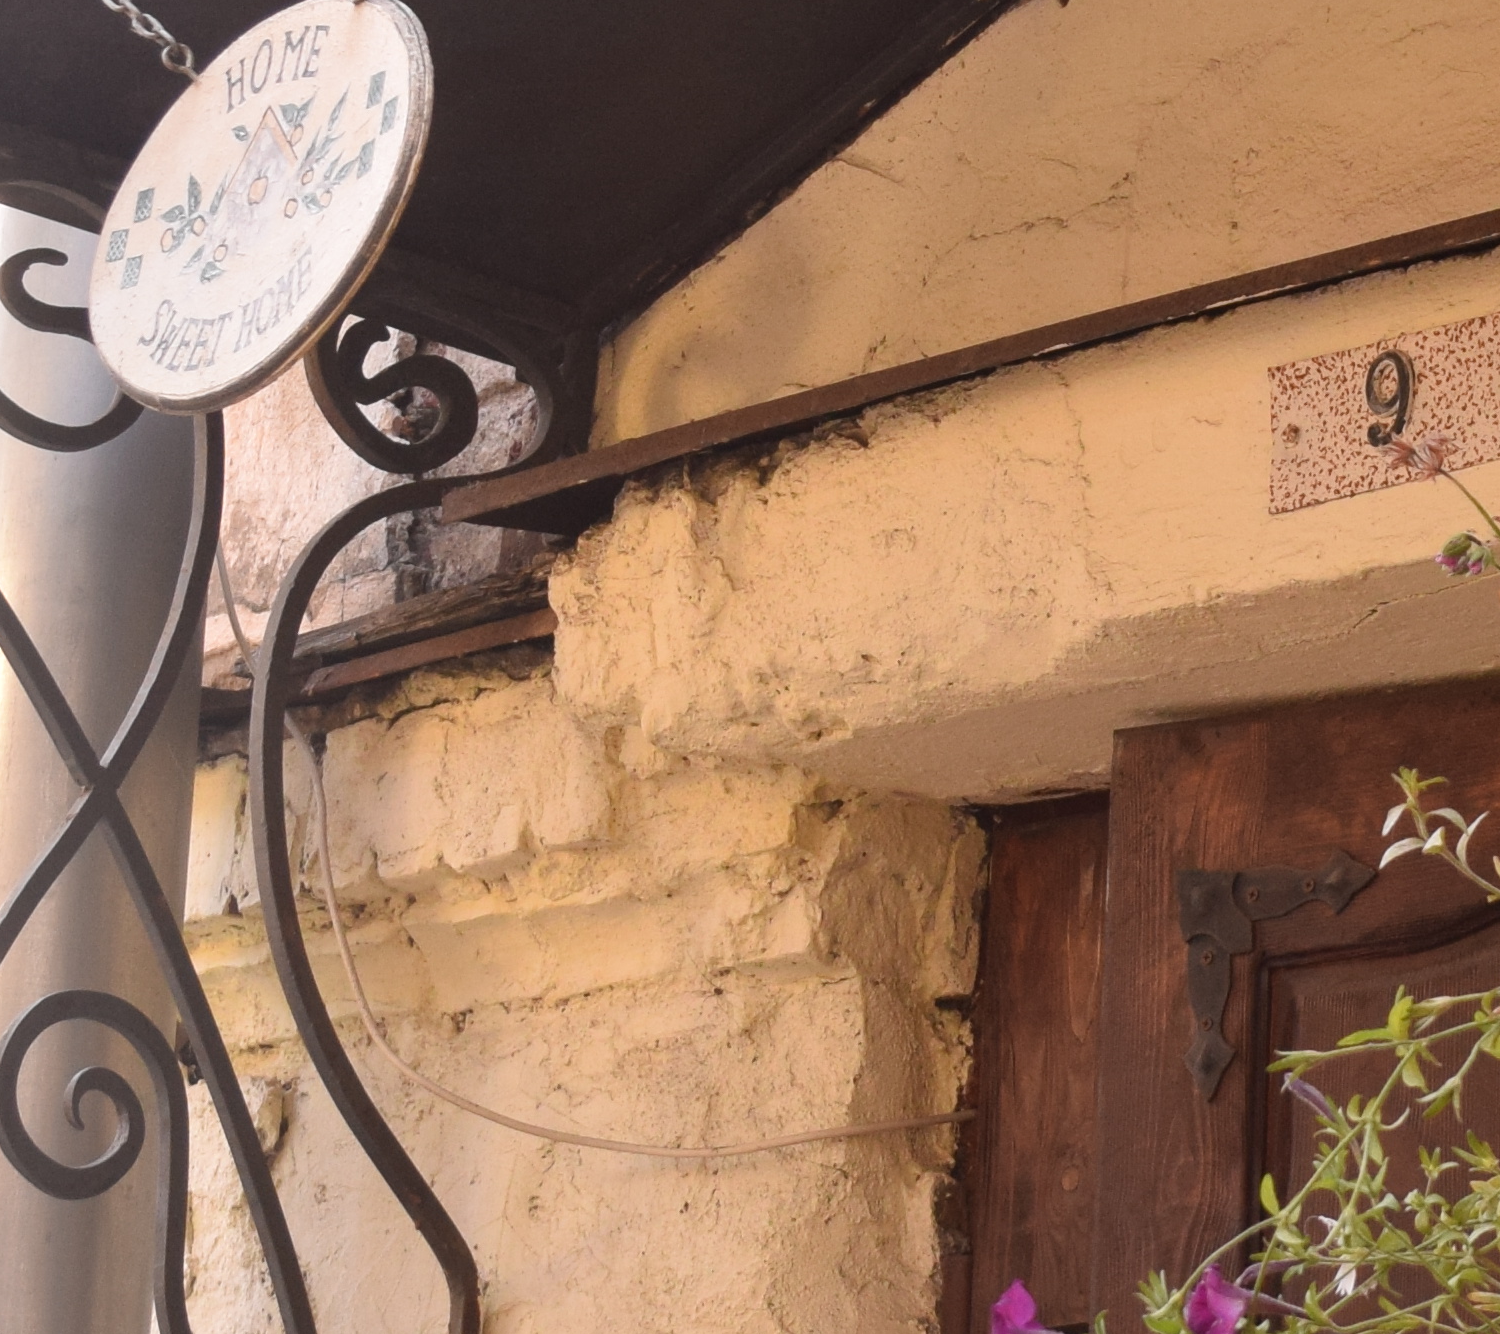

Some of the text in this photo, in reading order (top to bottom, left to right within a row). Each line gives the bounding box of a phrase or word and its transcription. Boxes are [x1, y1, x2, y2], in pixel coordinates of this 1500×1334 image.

[225, 25, 330, 113] HOME
[138, 247, 315, 372] SWEET HOME
[1365, 349, 1414, 447] 9
